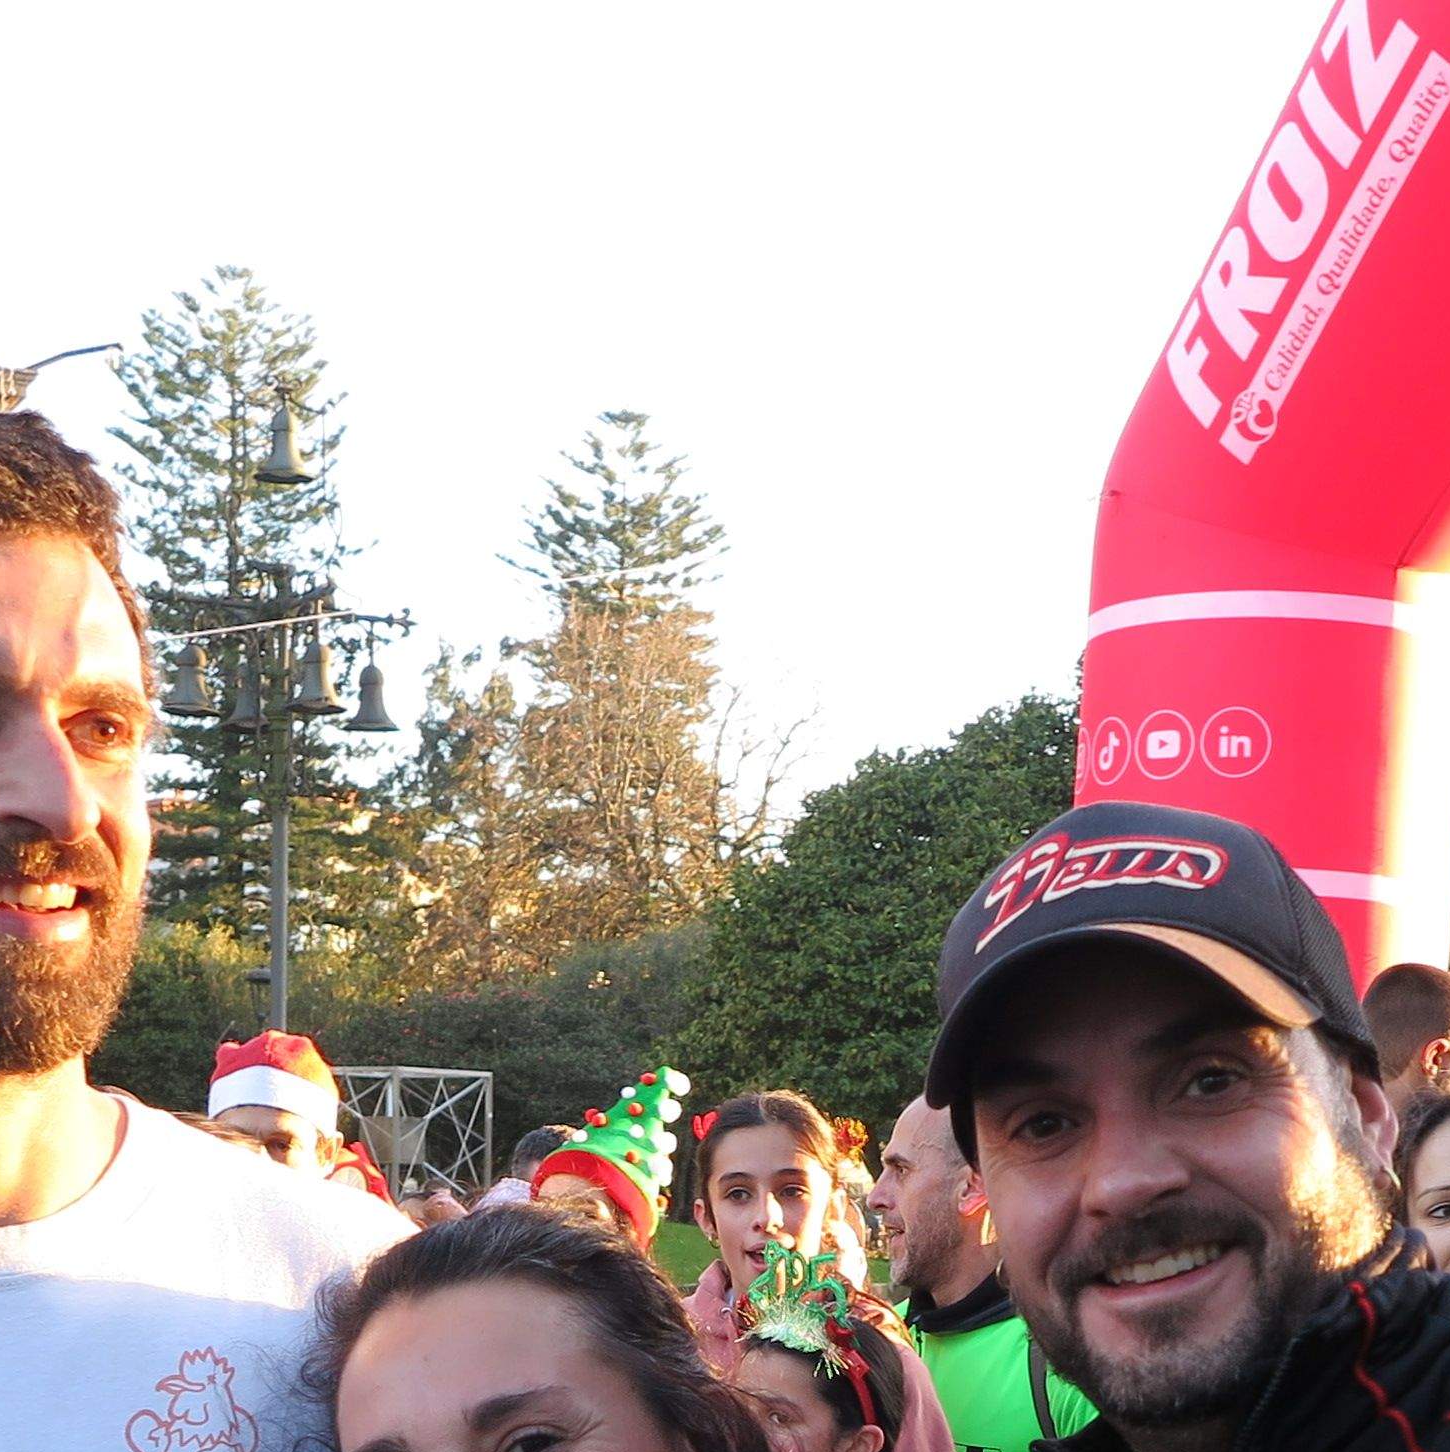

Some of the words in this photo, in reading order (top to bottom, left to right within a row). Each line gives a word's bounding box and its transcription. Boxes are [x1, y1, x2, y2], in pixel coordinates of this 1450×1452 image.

[1166, 0, 1419, 430] FROIZ
[1264, 305, 1327, 393] Calidad,
[1316, 175, 1397, 297] Qualidade,
[1388, 71, 1450, 164] Quality
